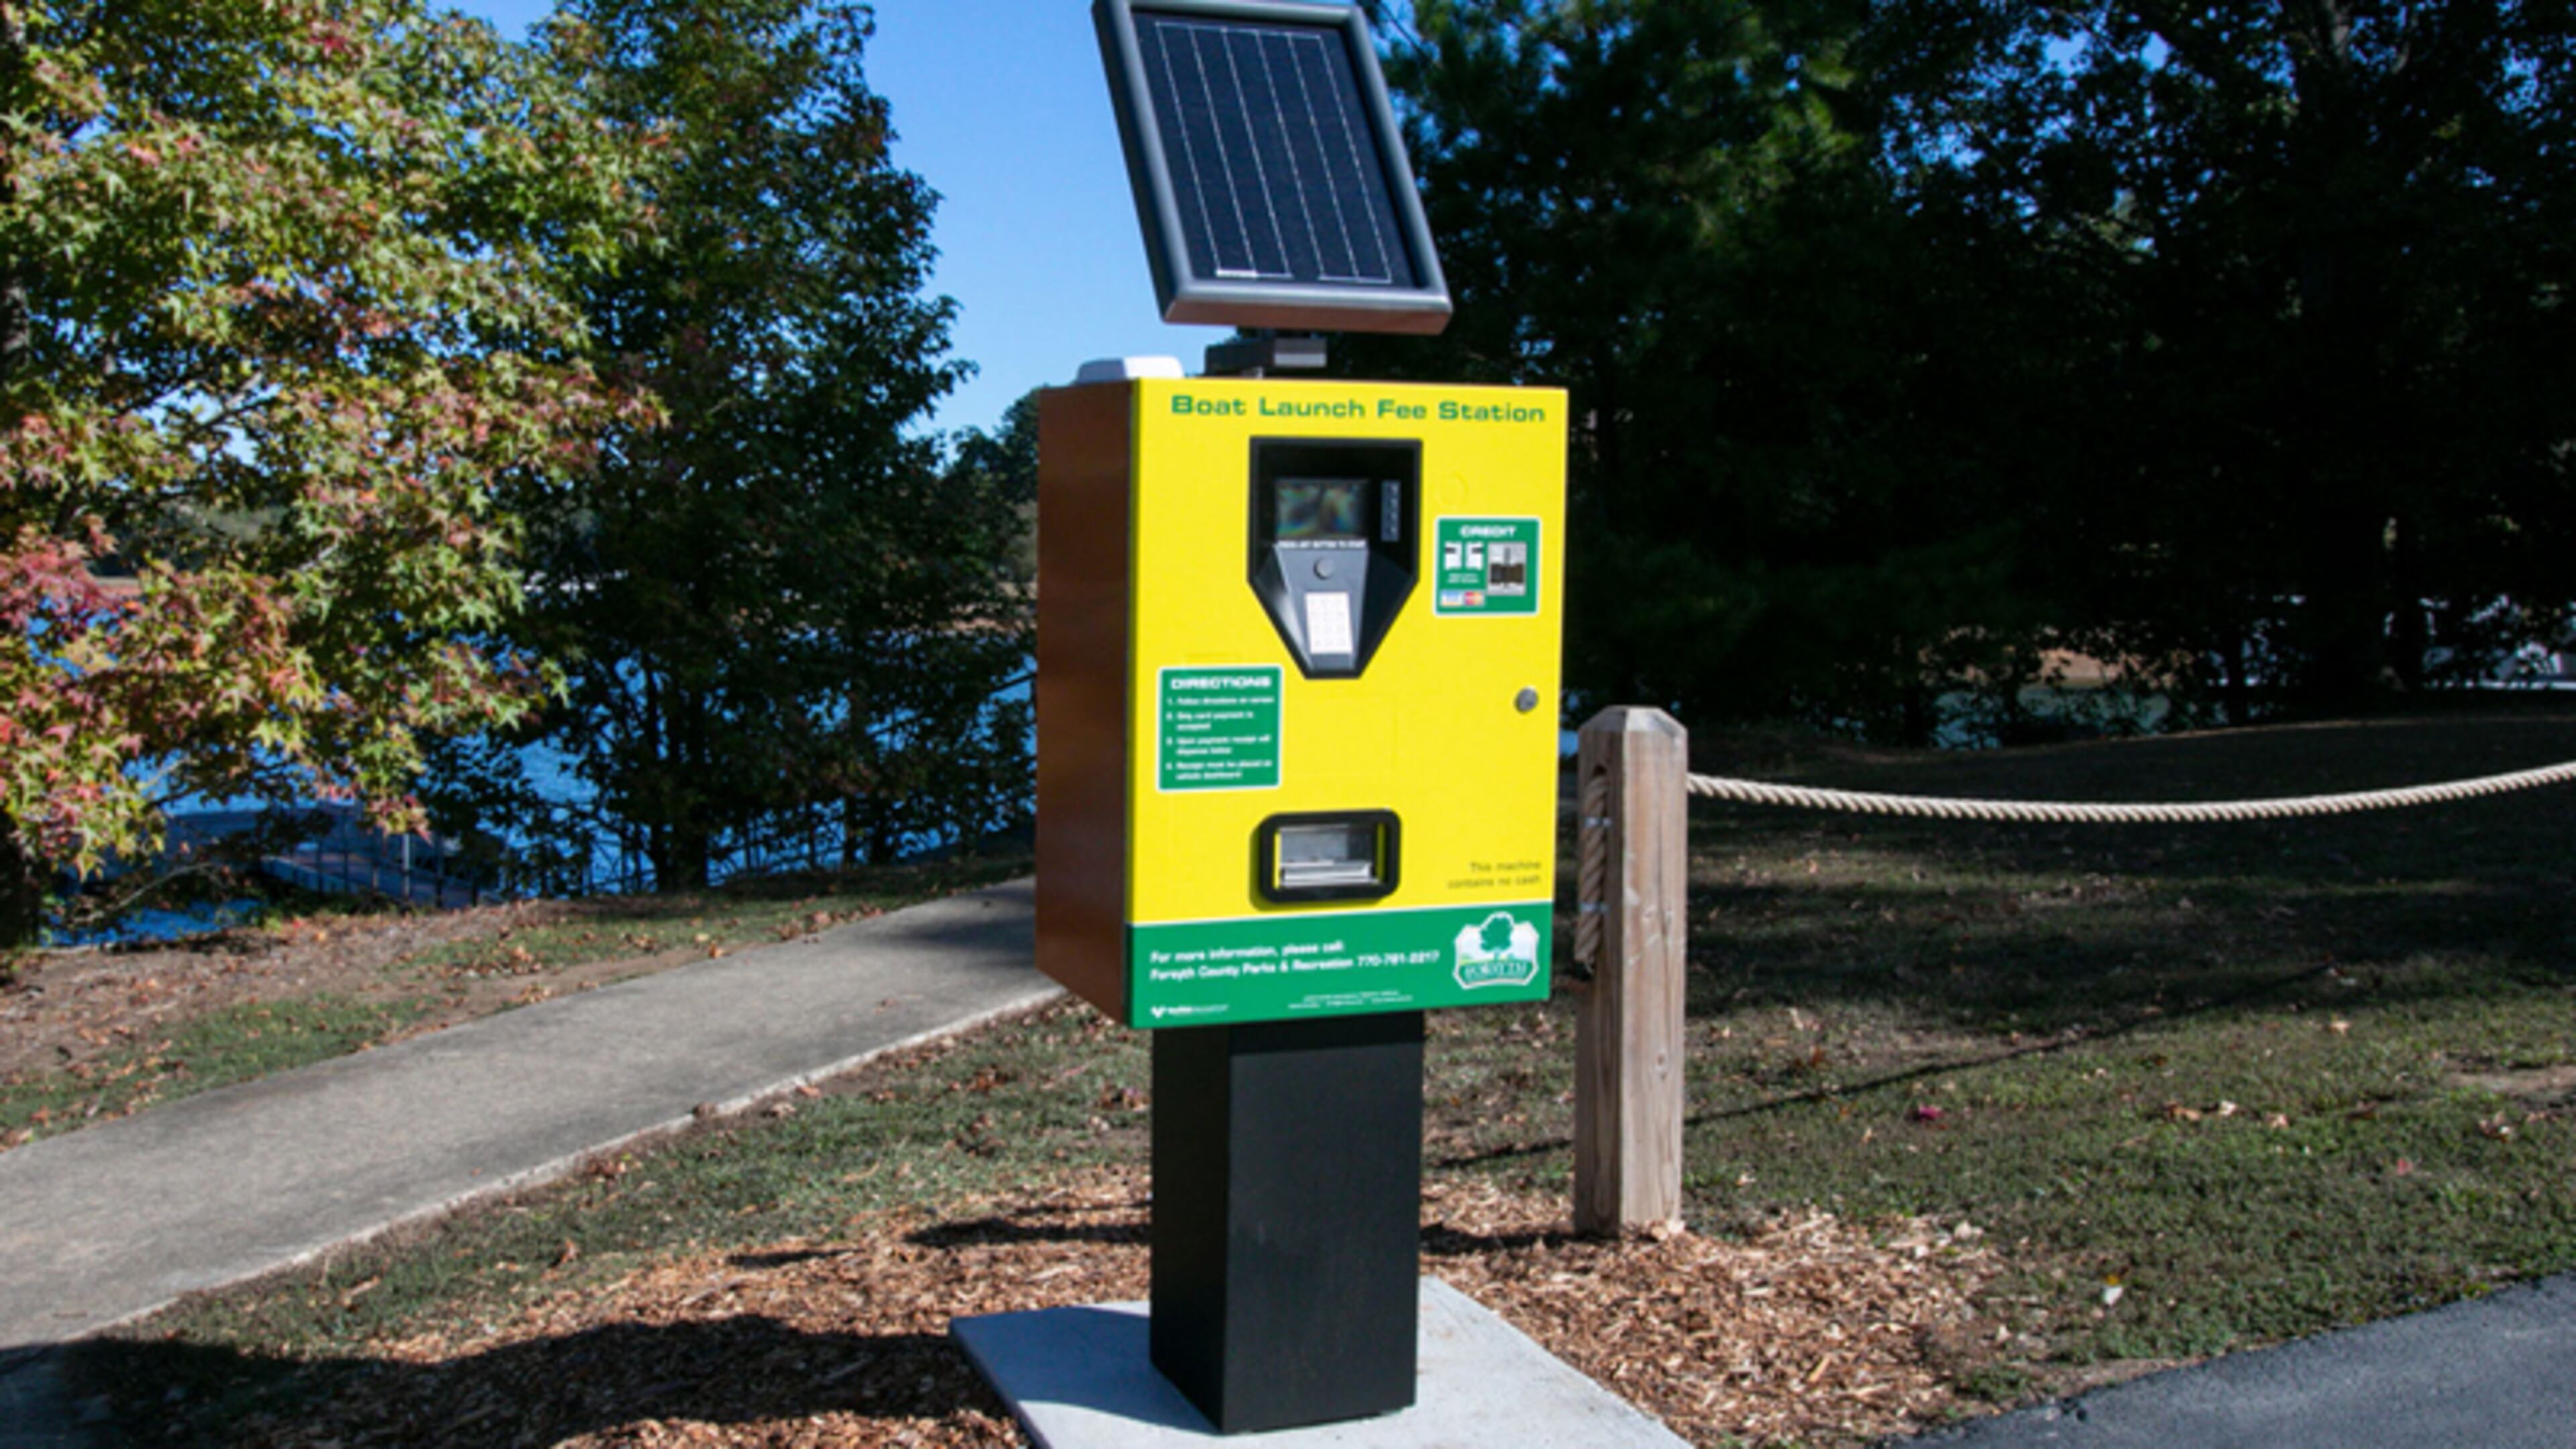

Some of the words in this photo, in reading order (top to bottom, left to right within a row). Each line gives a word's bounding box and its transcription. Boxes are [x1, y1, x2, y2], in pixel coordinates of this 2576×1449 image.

[1171, 394, 1246, 416] Boat
[1259, 396, 1366, 419] Launch
[1377, 398, 1427, 419] Fee
[1438, 401, 1546, 422] Station
[1460, 525, 1516, 537] CREDIT
[1171, 676, 1272, 690] DIRECTIONS
[1150, 951, 1171, 963] For
[1175, 951, 1205, 961] more
[1282, 944, 1319, 957] please
[1150, 967, 1195, 982] Forsyth
[1198, 965, 1240, 979] County
[1242, 962, 1276, 974] Parks
[1279, 960, 1288, 973] &
[1292, 958, 1354, 971] Recreation
